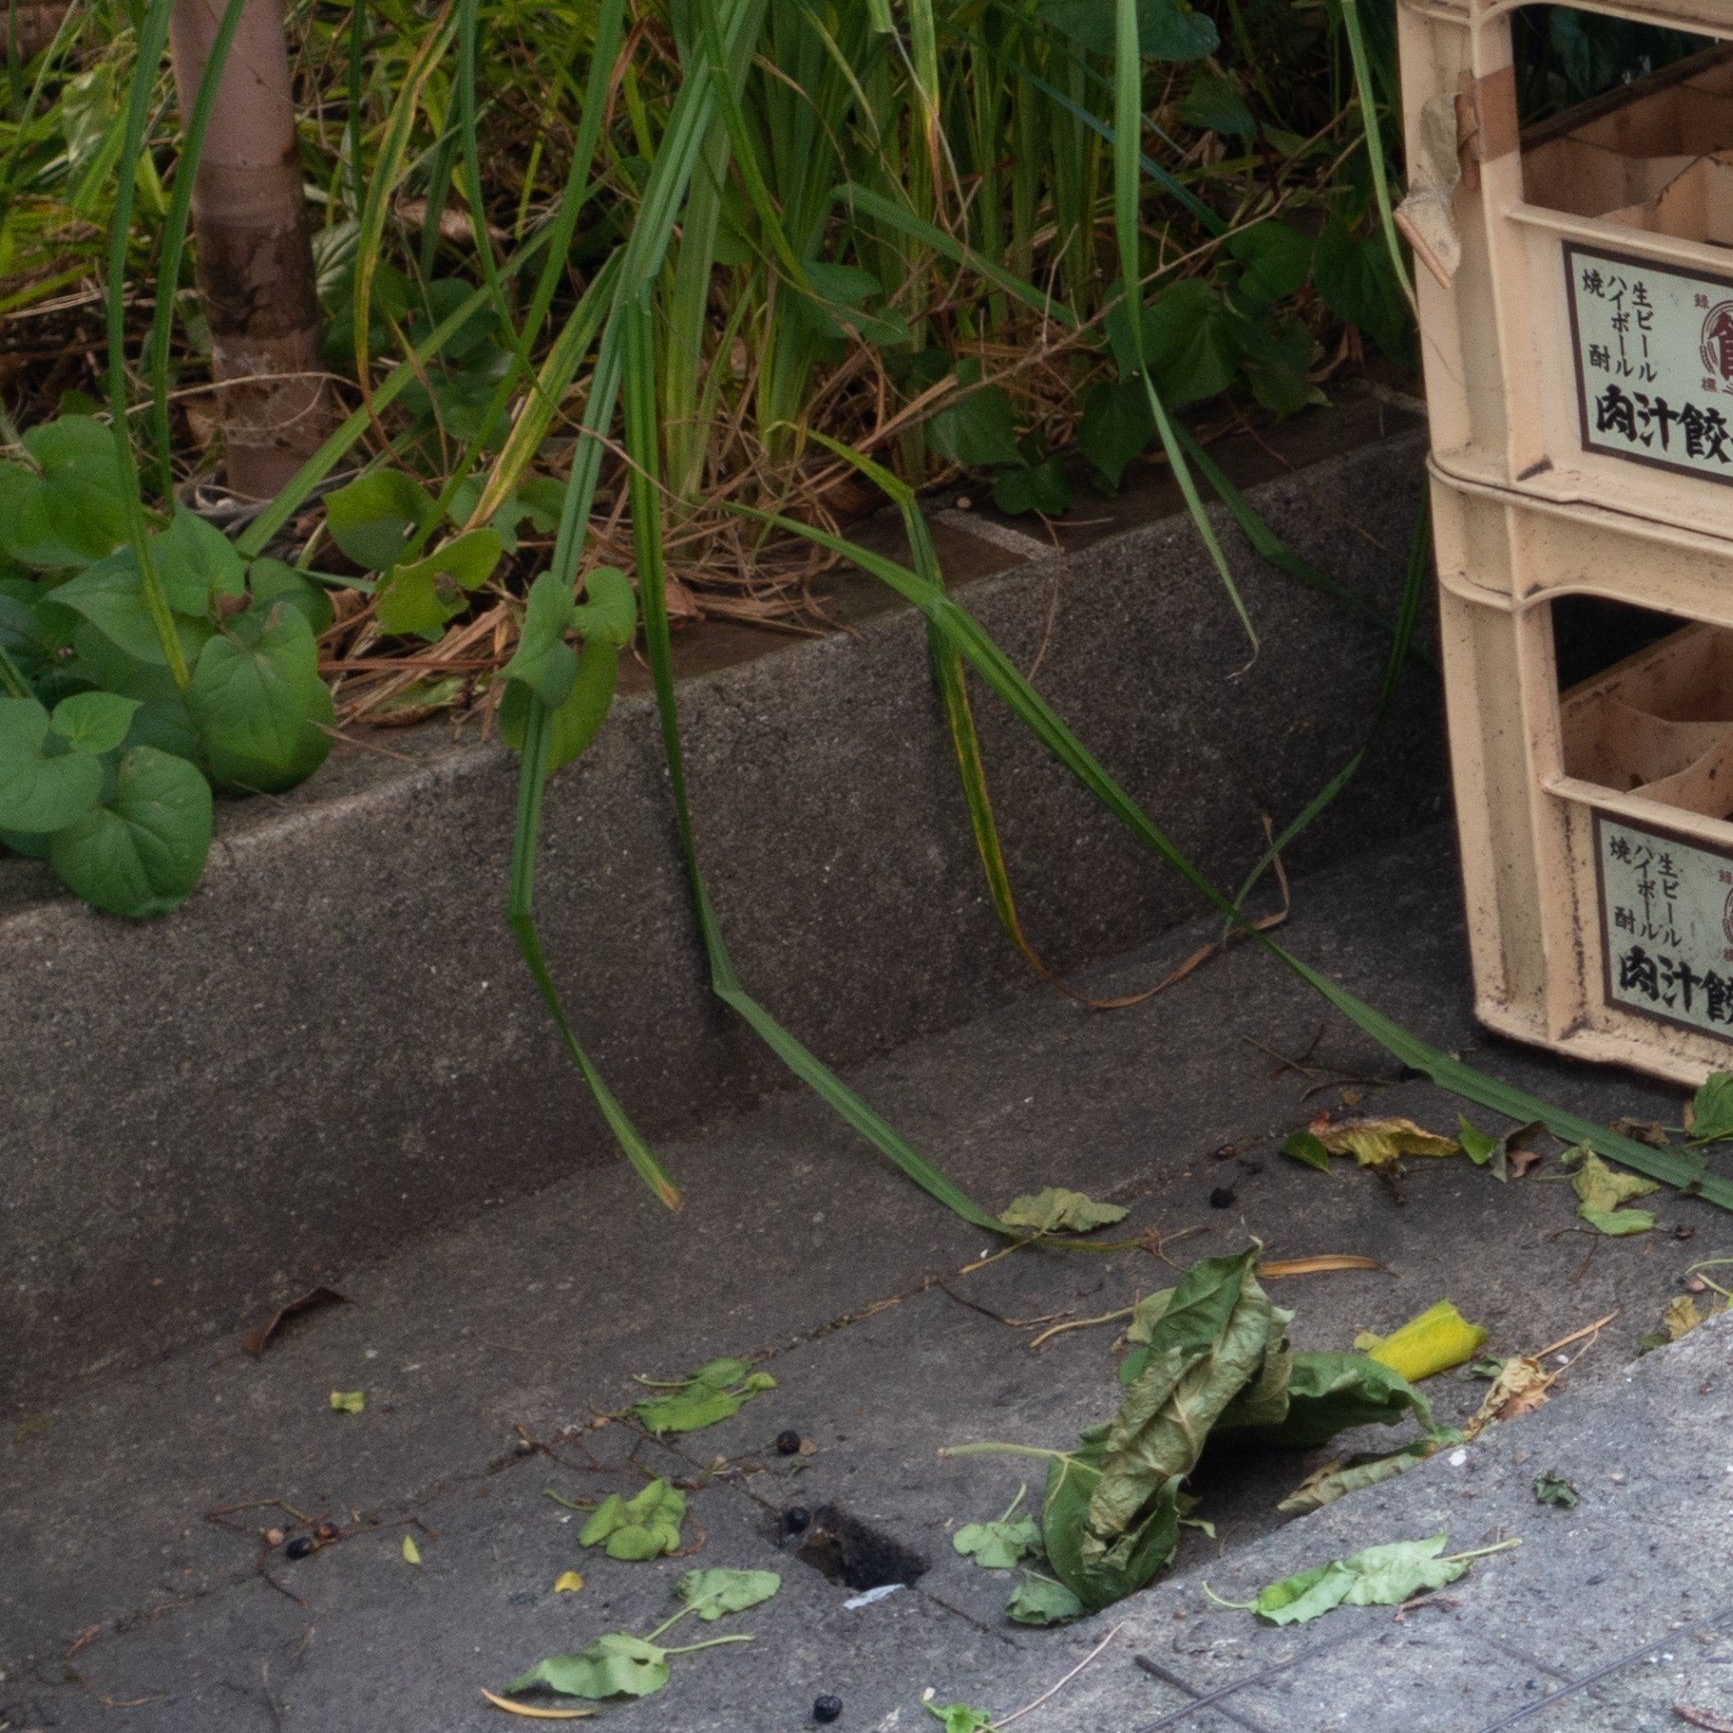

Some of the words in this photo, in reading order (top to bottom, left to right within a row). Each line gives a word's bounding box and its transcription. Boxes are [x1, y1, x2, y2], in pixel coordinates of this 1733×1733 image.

[1608, 275, 1634, 377] ハイボール
[1631, 281, 1658, 383] 生ビール
[1634, 844, 1659, 941] ハイボール
[1657, 852, 1682, 948] 生ビール
